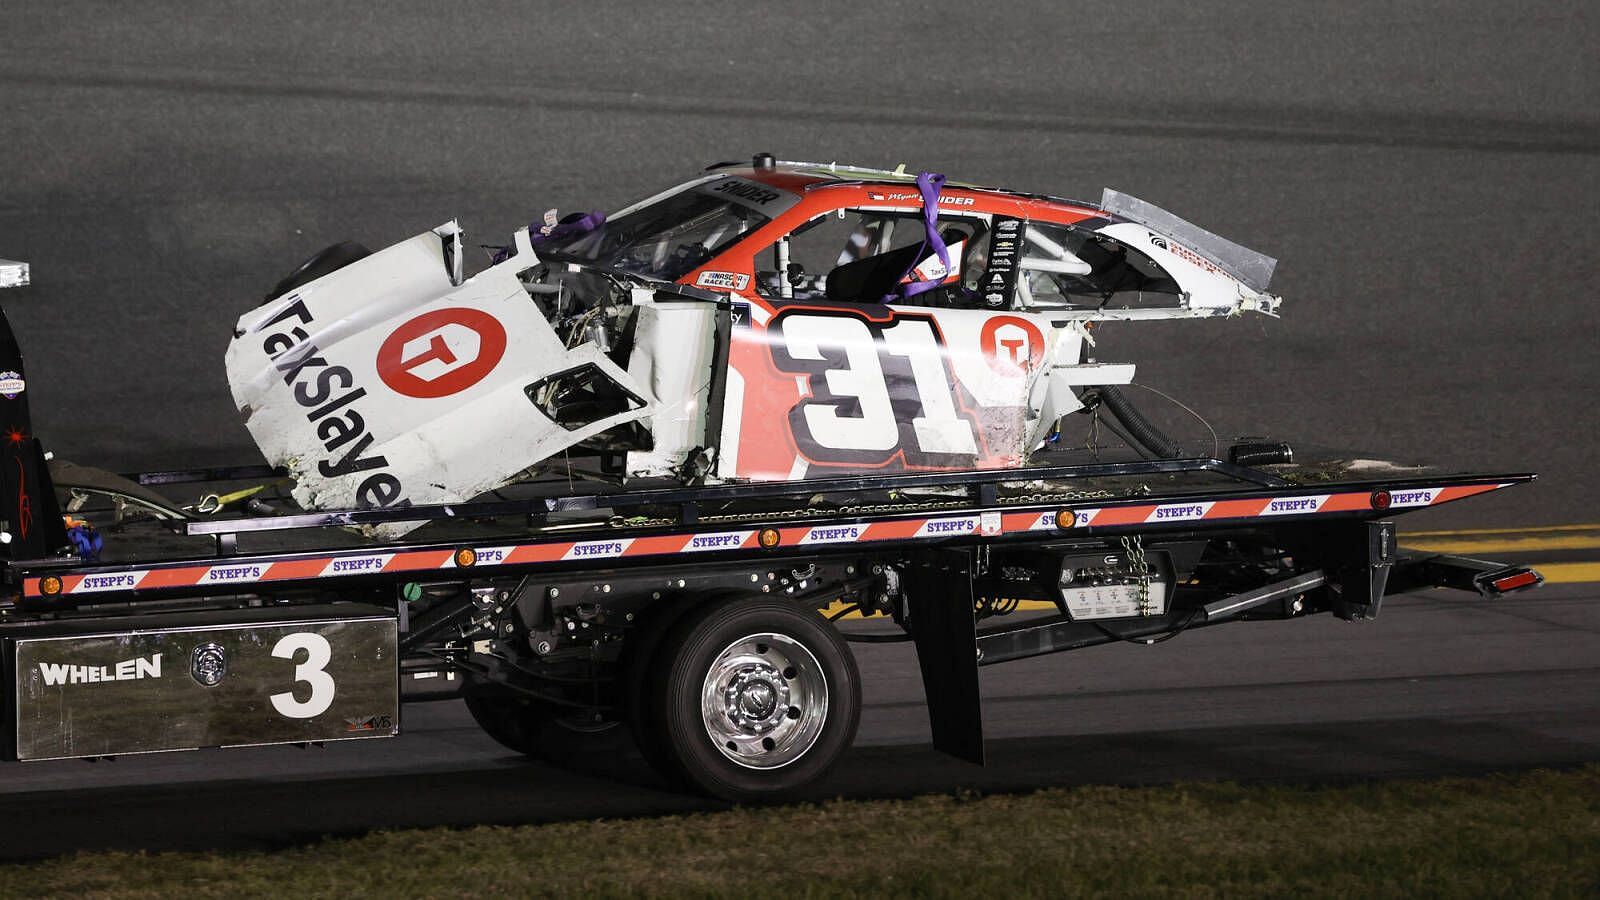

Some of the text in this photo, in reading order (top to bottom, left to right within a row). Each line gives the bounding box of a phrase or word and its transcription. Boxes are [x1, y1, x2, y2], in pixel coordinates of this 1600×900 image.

[714, 181, 780, 205] SNIDER
[713, 272, 743, 282] NASCR
[782, 314, 978, 454] 31
[1391, 491, 1431, 504] TEPP'S
[1156, 506, 1203, 518] STEPP'S
[1271, 499, 1317, 512] STEPP'S
[927, 520, 974, 533] STEPP'S
[811, 527, 858, 540] STEPP'S
[693, 535, 740, 548] STEPP'S
[574, 543, 622, 556] STEPP'S
[477, 551, 502, 562] PP'S
[333, 558, 382, 571] STEPP'S
[210, 567, 260, 580] STEPP'S
[84, 574, 135, 589] STEPP'S
[39, 652, 162, 686] WHELEN
[270, 632, 336, 719] 3
